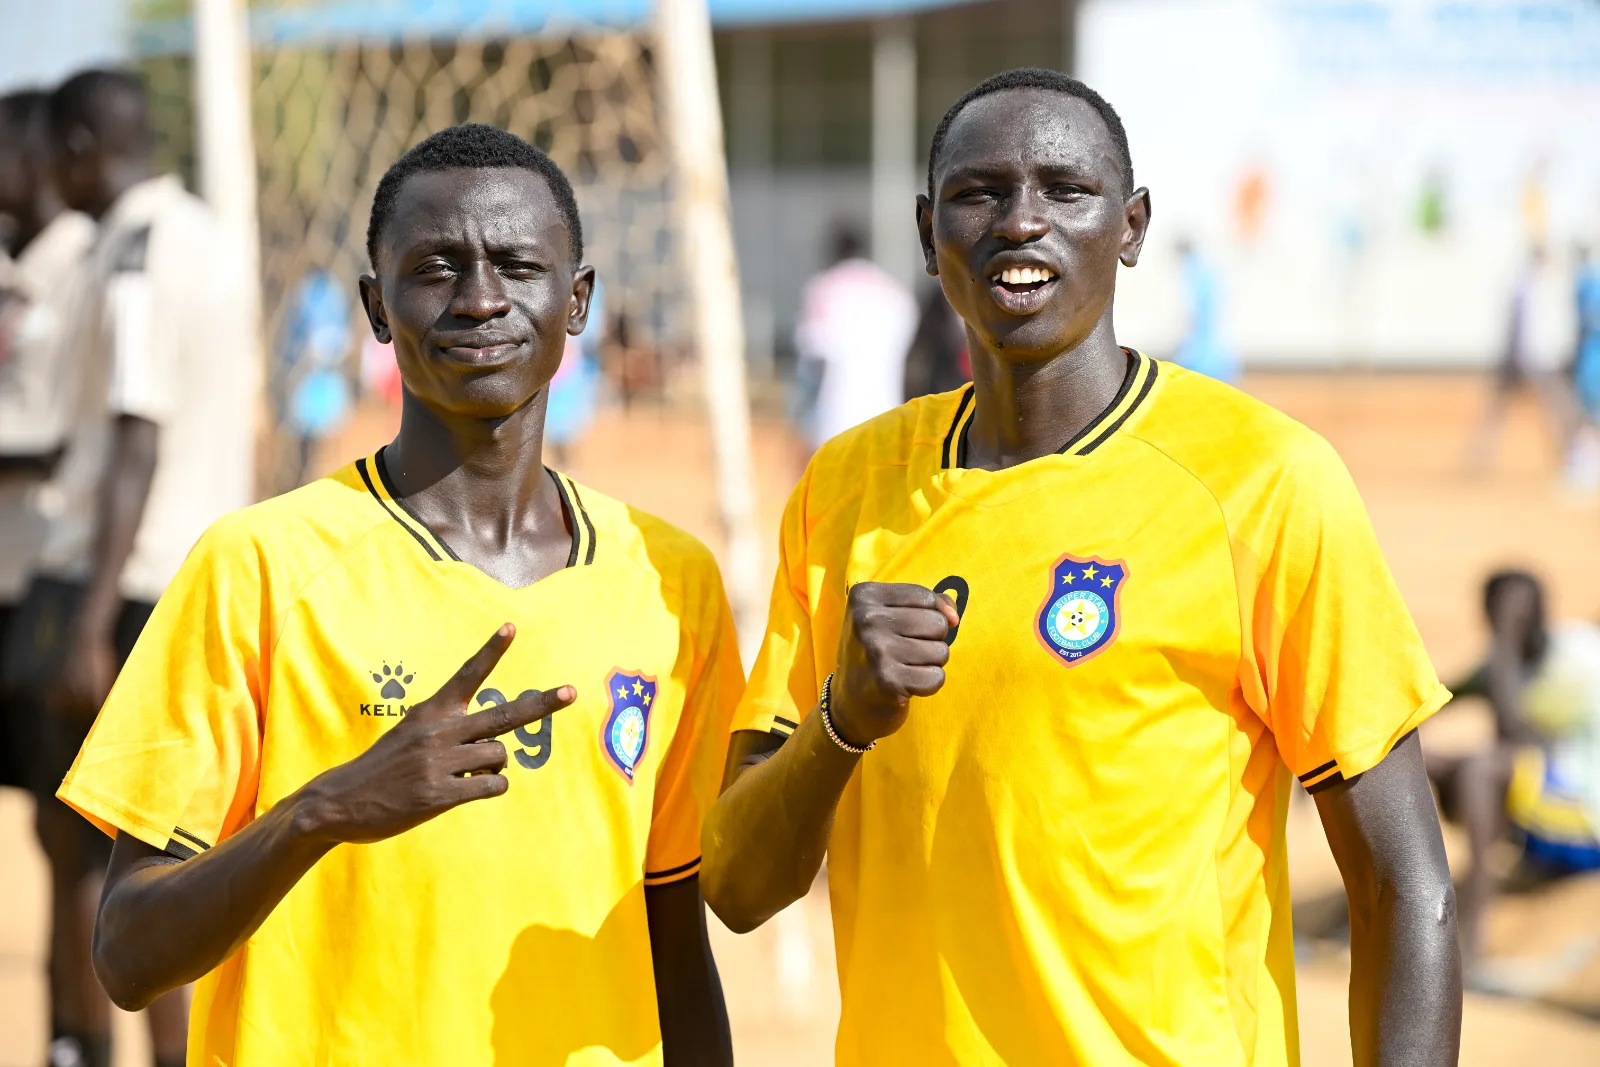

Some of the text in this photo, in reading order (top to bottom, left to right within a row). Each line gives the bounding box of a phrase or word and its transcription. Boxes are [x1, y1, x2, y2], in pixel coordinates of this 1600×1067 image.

[1056, 592, 1106, 612] SUPER STAR
[1049, 626, 1101, 648] FOOTBALL CLUB
[1059, 649, 1070, 657] EST
